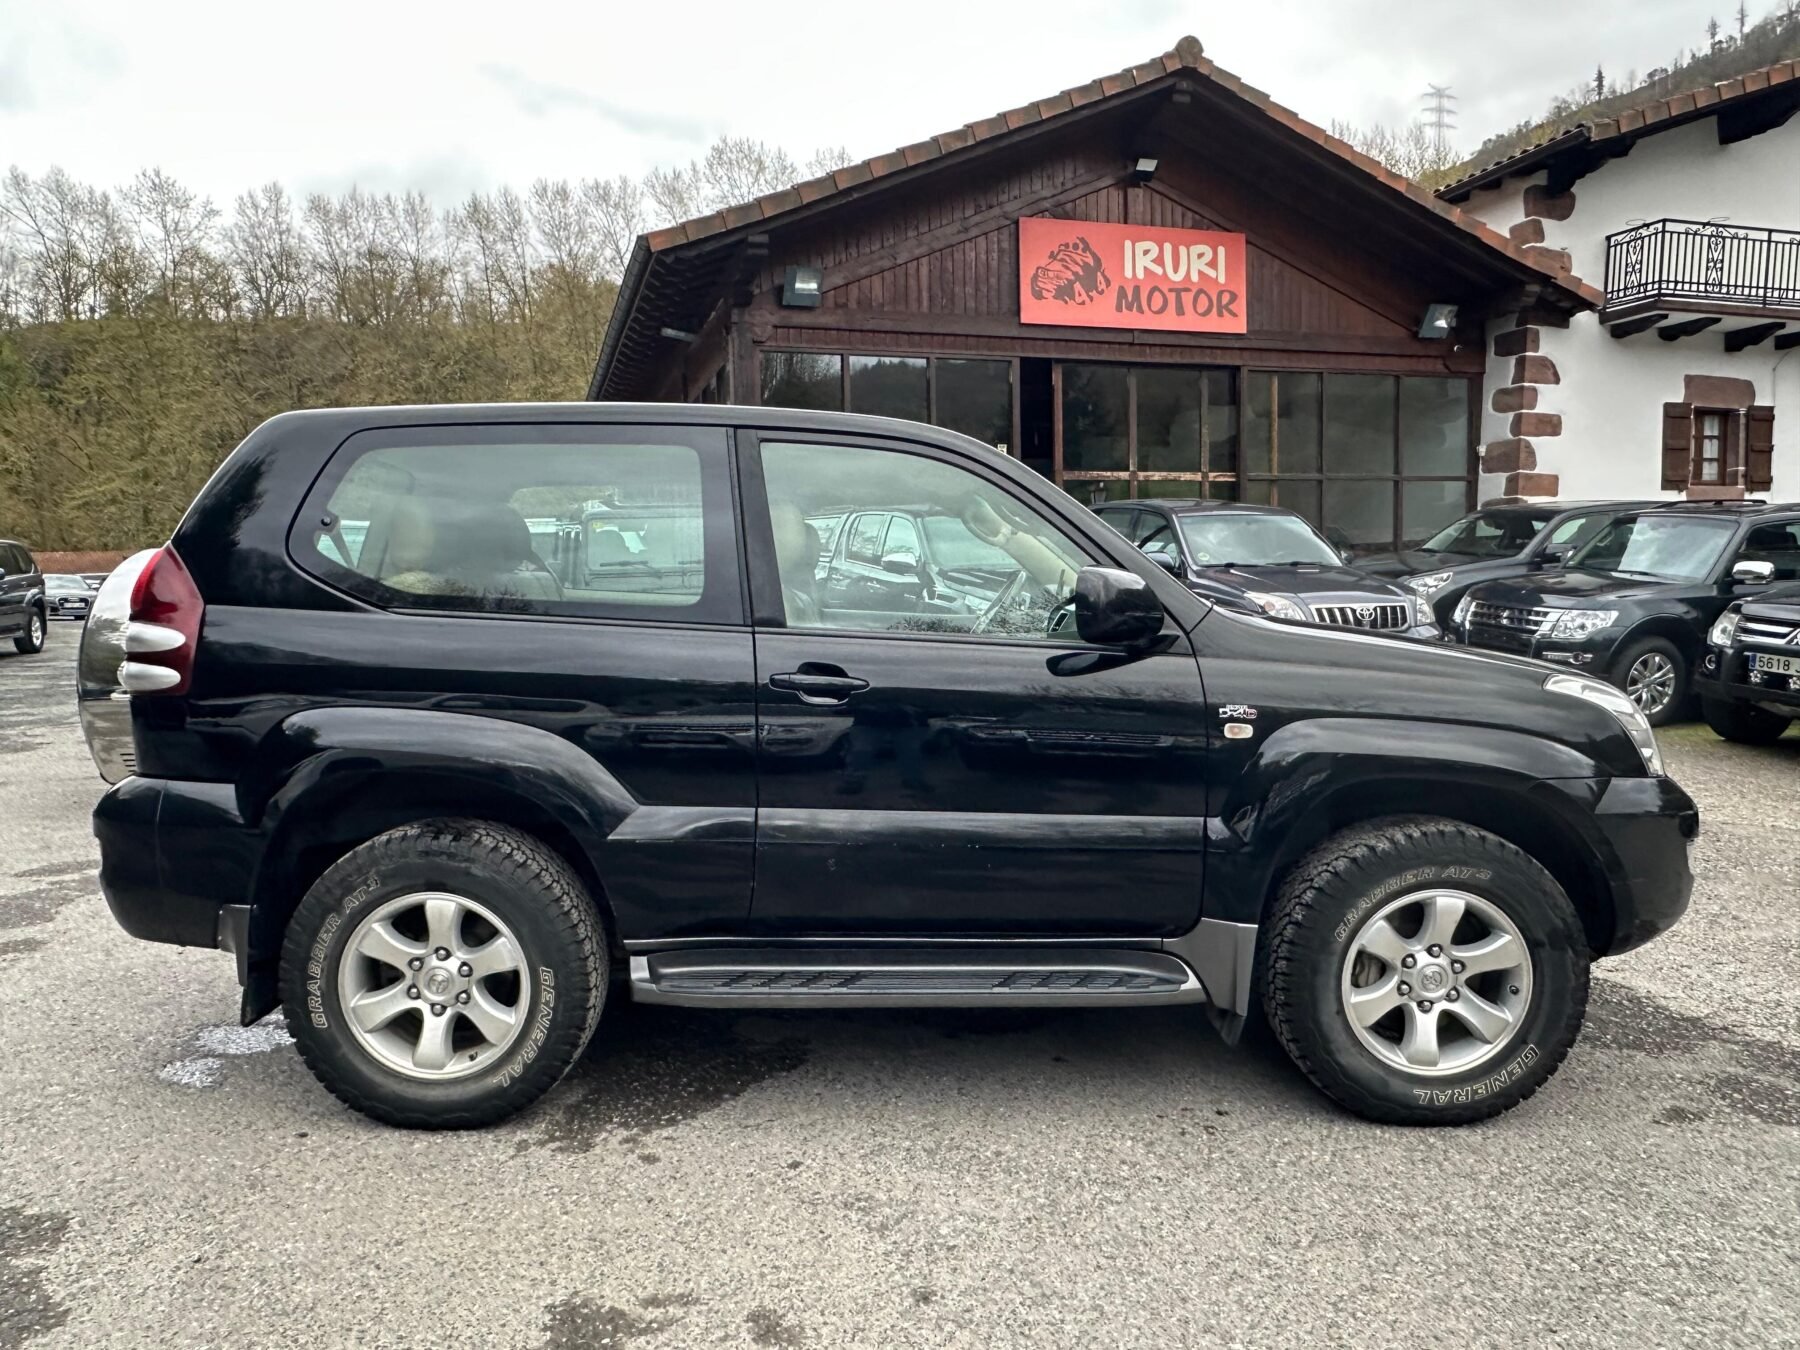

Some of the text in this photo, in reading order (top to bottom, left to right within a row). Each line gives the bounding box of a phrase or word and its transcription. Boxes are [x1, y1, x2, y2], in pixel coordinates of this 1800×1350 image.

[1124, 240, 1225, 284] IRURI
[1115, 285, 1238, 317] MOTOR
[1758, 656, 1790, 671] 5618
[1335, 865, 1492, 942] GRABBER AT3
[306, 913, 341, 1028] GRABBER
[493, 966, 555, 1087] GENERAL
[1414, 1044, 1540, 1105] GENERAL
